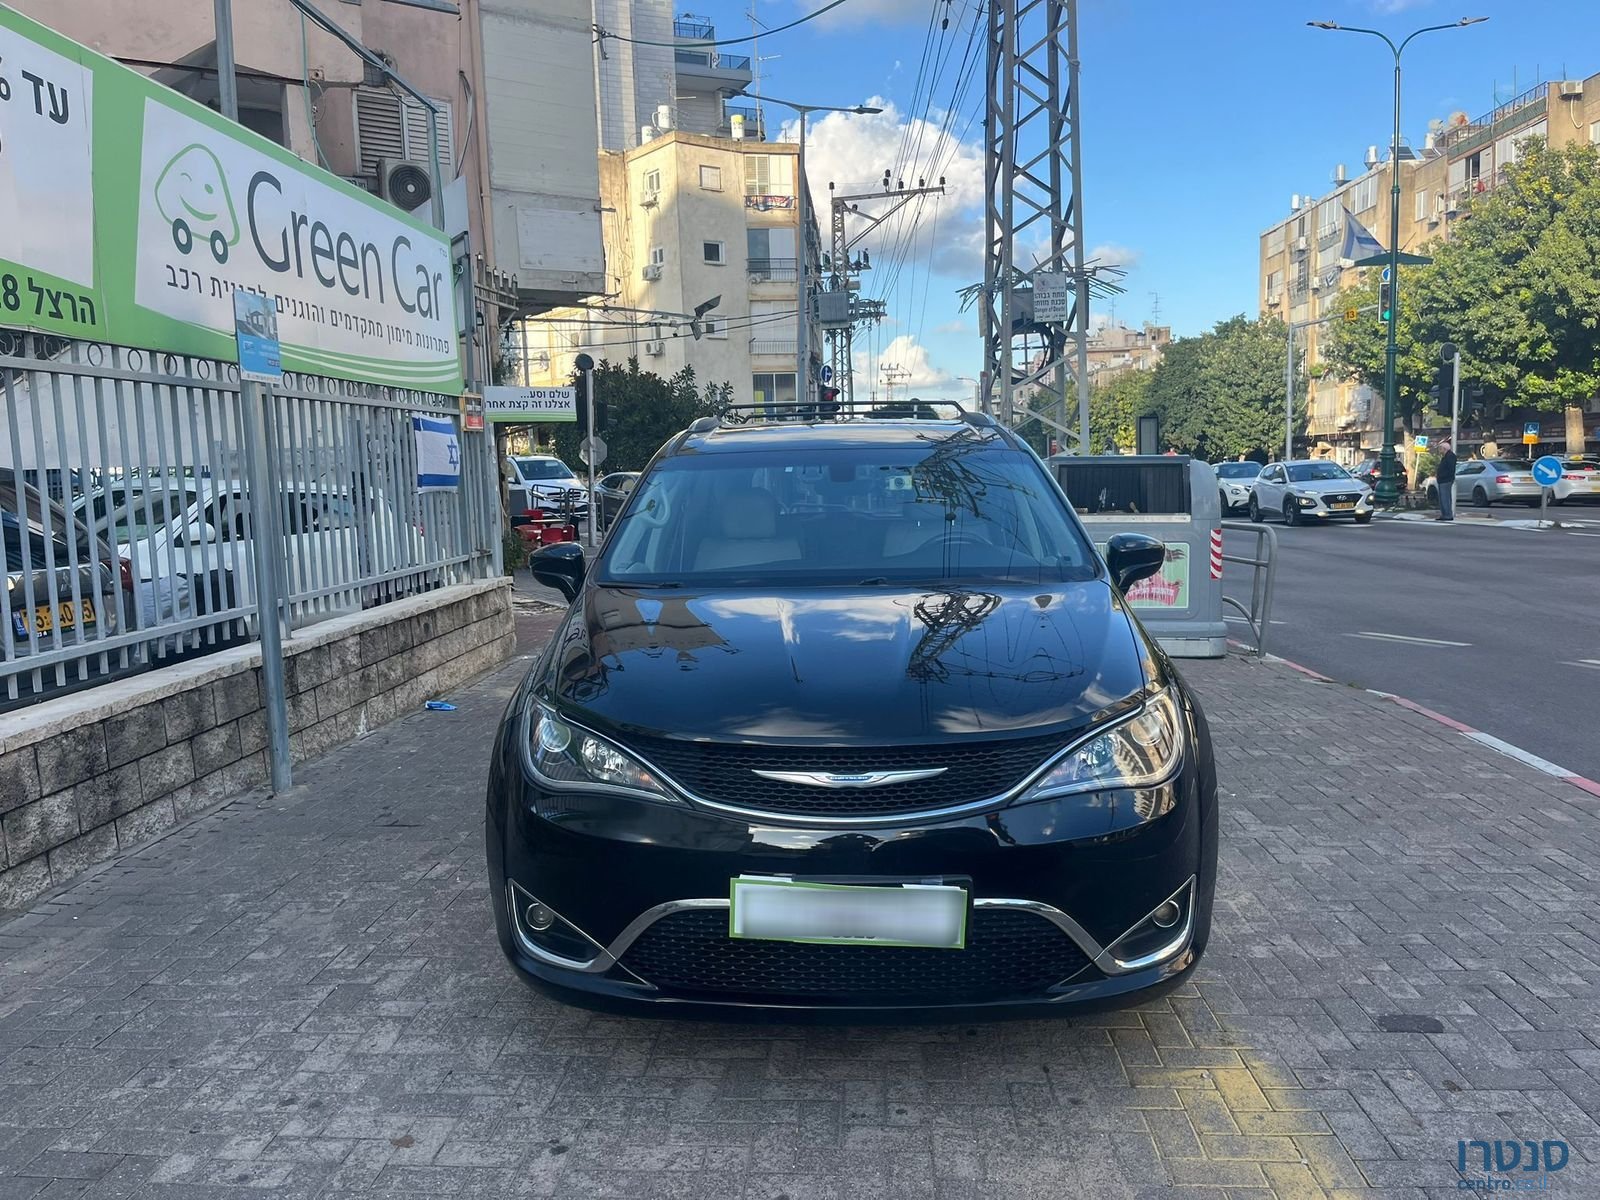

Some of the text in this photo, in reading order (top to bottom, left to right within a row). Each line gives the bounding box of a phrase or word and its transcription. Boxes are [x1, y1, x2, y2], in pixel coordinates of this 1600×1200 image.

[21, 69, 69, 124] עד
[247, 170, 442, 321] Green Car
[166, 264, 202, 294] רכב
[28, 276, 96, 325] הרצל
[275, 294, 325, 324] והוגנים
[330, 309, 383, 339] מתקדמים
[1346, 310, 1355, 319] 13
[387, 324, 413, 345] מימון
[416, 332, 449, 354] פתרונות
[520, 389, 570, 399] שלם וסע...
[531, 400, 544, 409] זה
[545, 399, 571, 409] אצלנו
[508, 400, 529, 411] קצת
